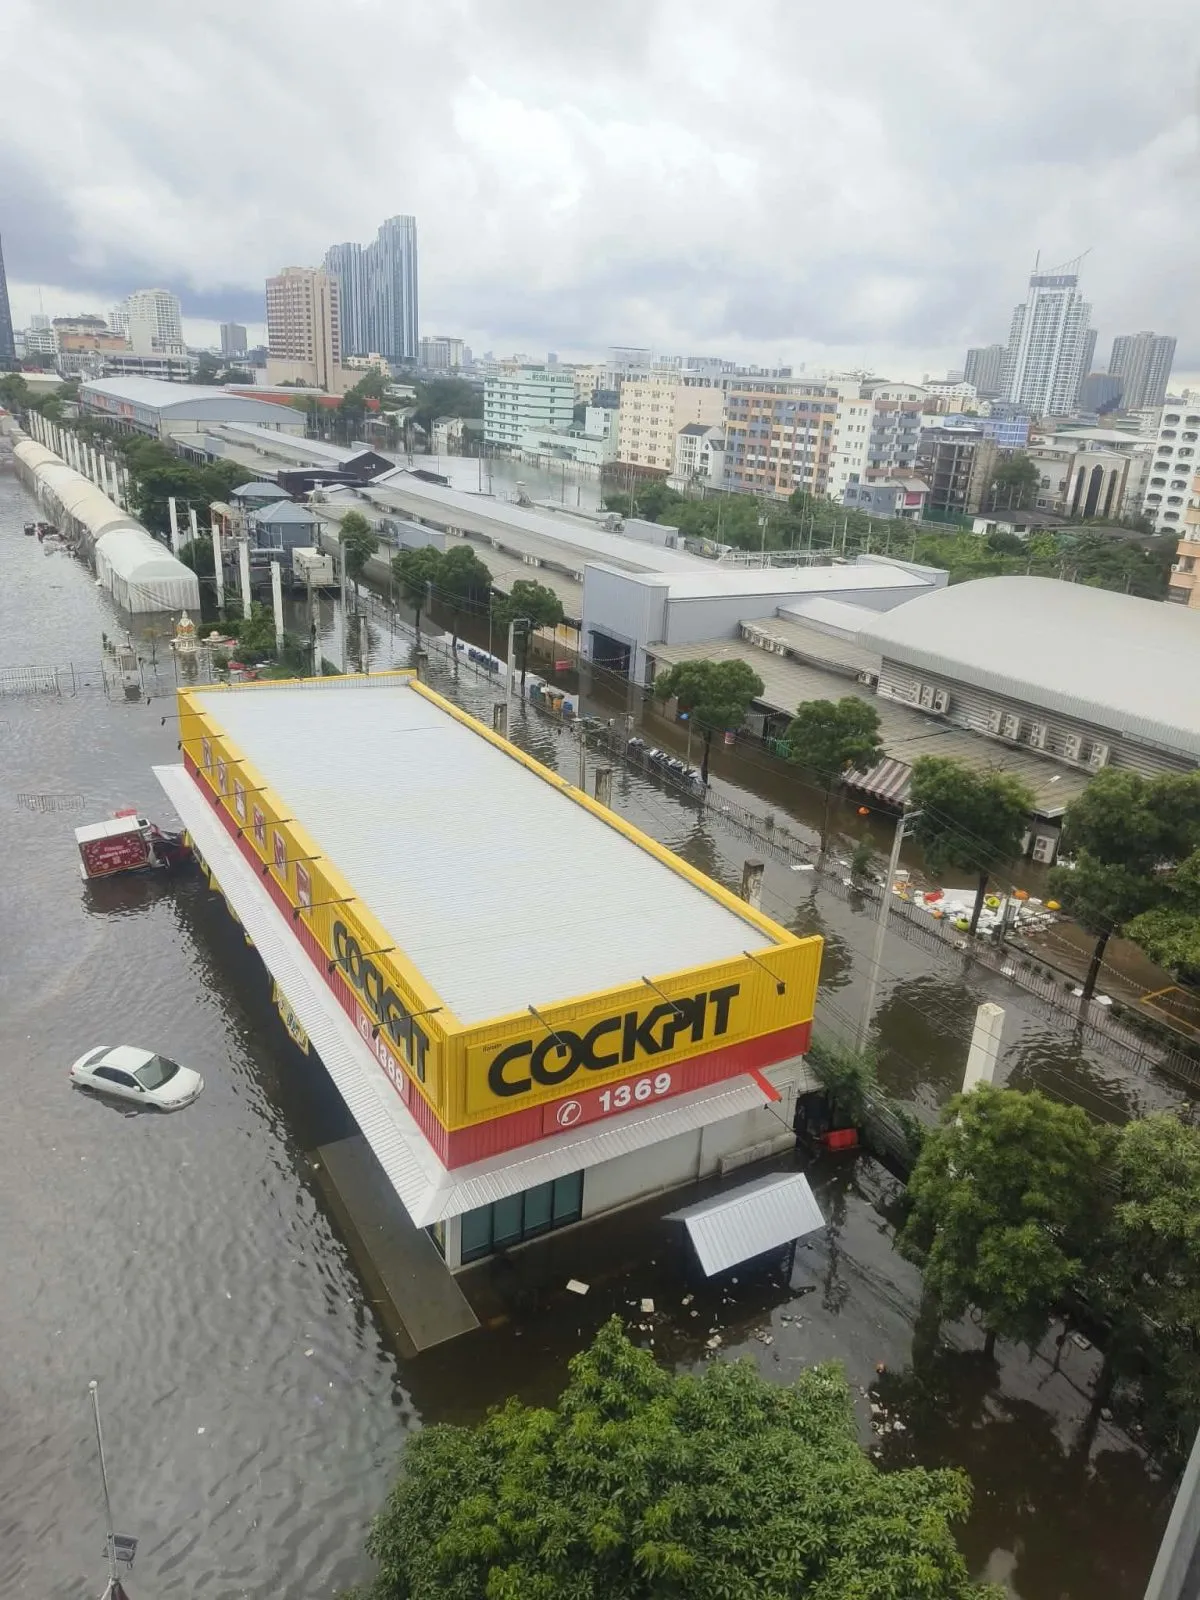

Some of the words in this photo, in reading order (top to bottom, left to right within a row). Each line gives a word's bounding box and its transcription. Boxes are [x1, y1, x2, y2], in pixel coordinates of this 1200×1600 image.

[333, 920, 429, 1083] COCKPIT
[488, 984, 740, 1097] COCKPIT
[599, 1072, 672, 1112] 1369
